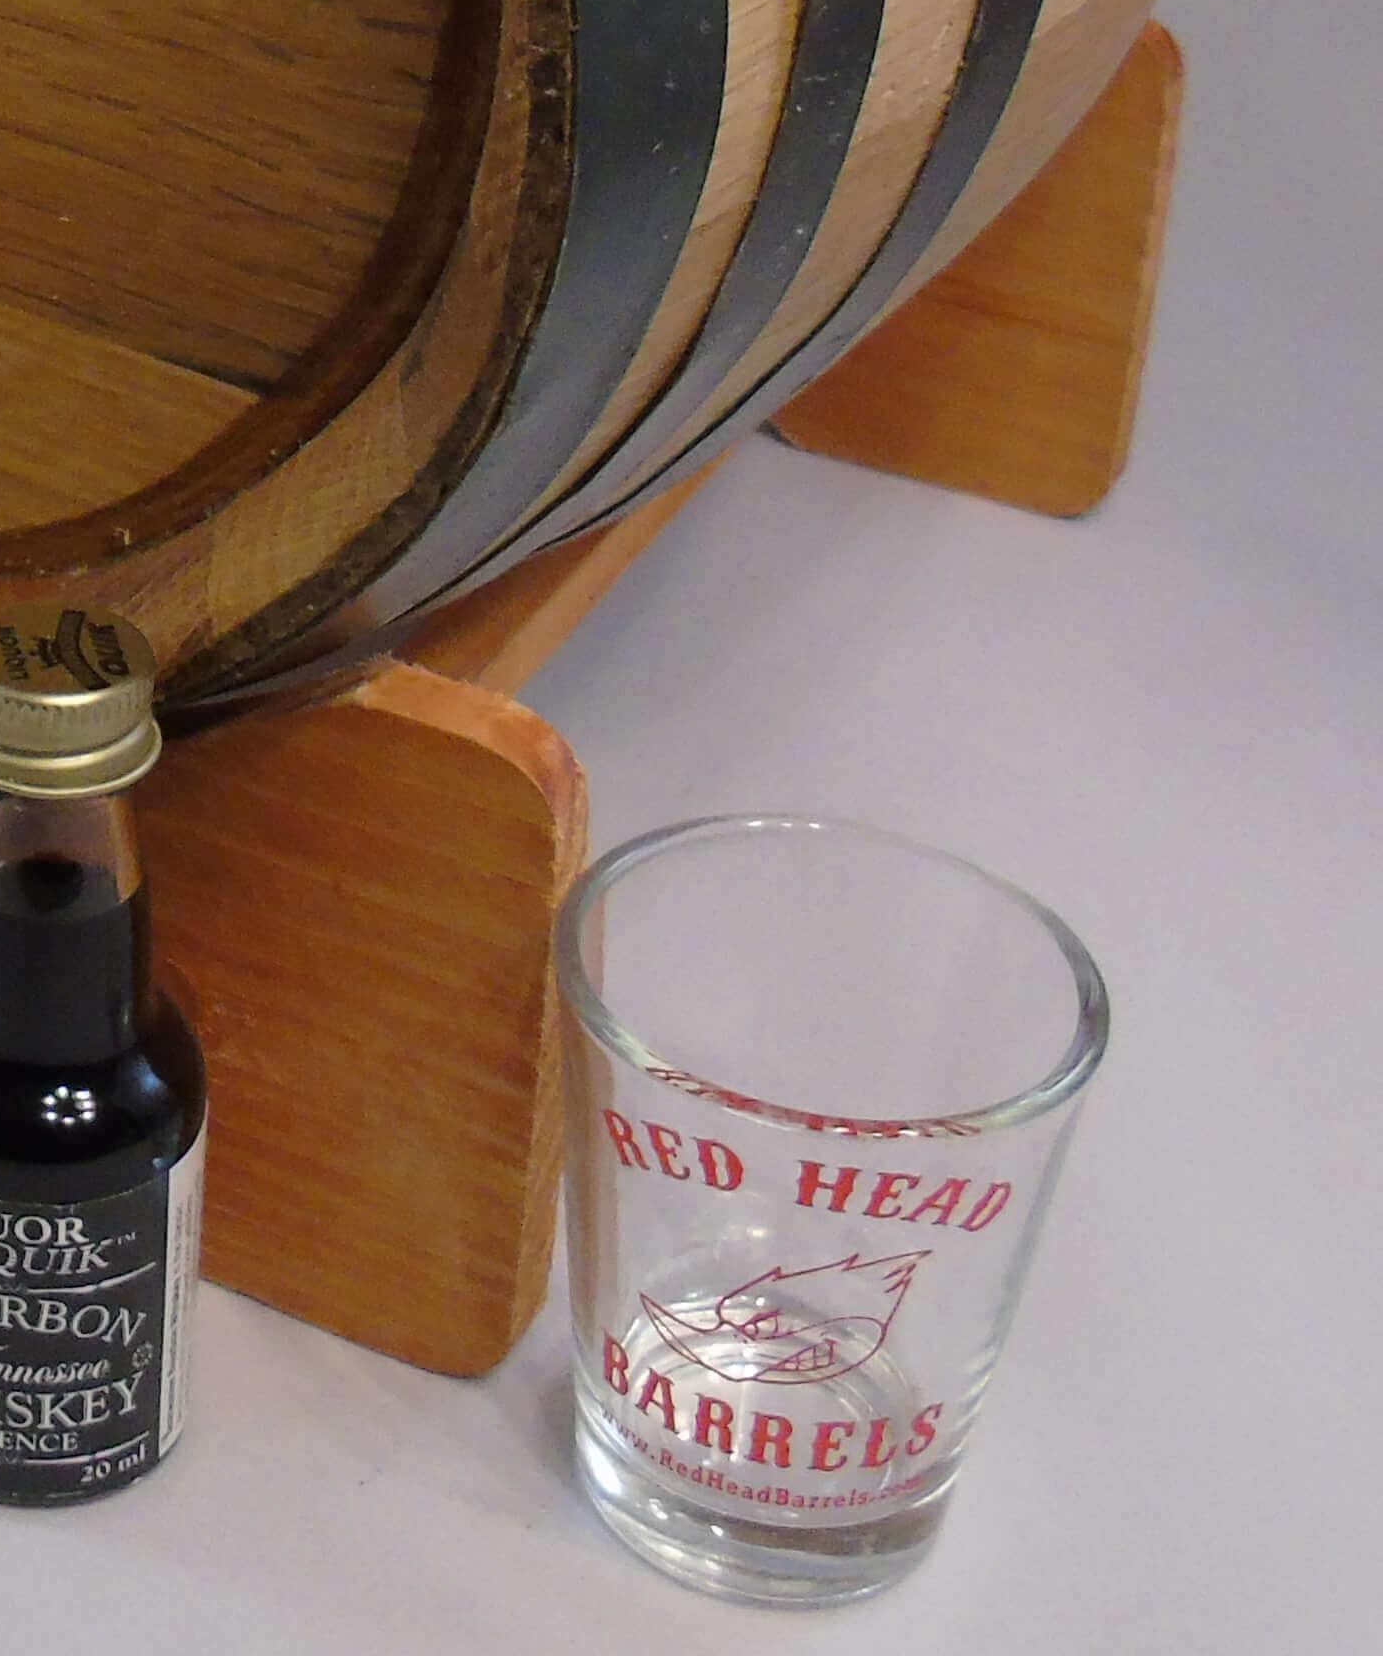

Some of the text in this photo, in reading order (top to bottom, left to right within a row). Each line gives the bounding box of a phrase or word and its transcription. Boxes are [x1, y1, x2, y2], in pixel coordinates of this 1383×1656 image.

[601, 1108, 1012, 1233] RED HEAD
[602, 1327, 944, 1471] BARRELS
[81, 1444, 147, 1483] 20 ml
